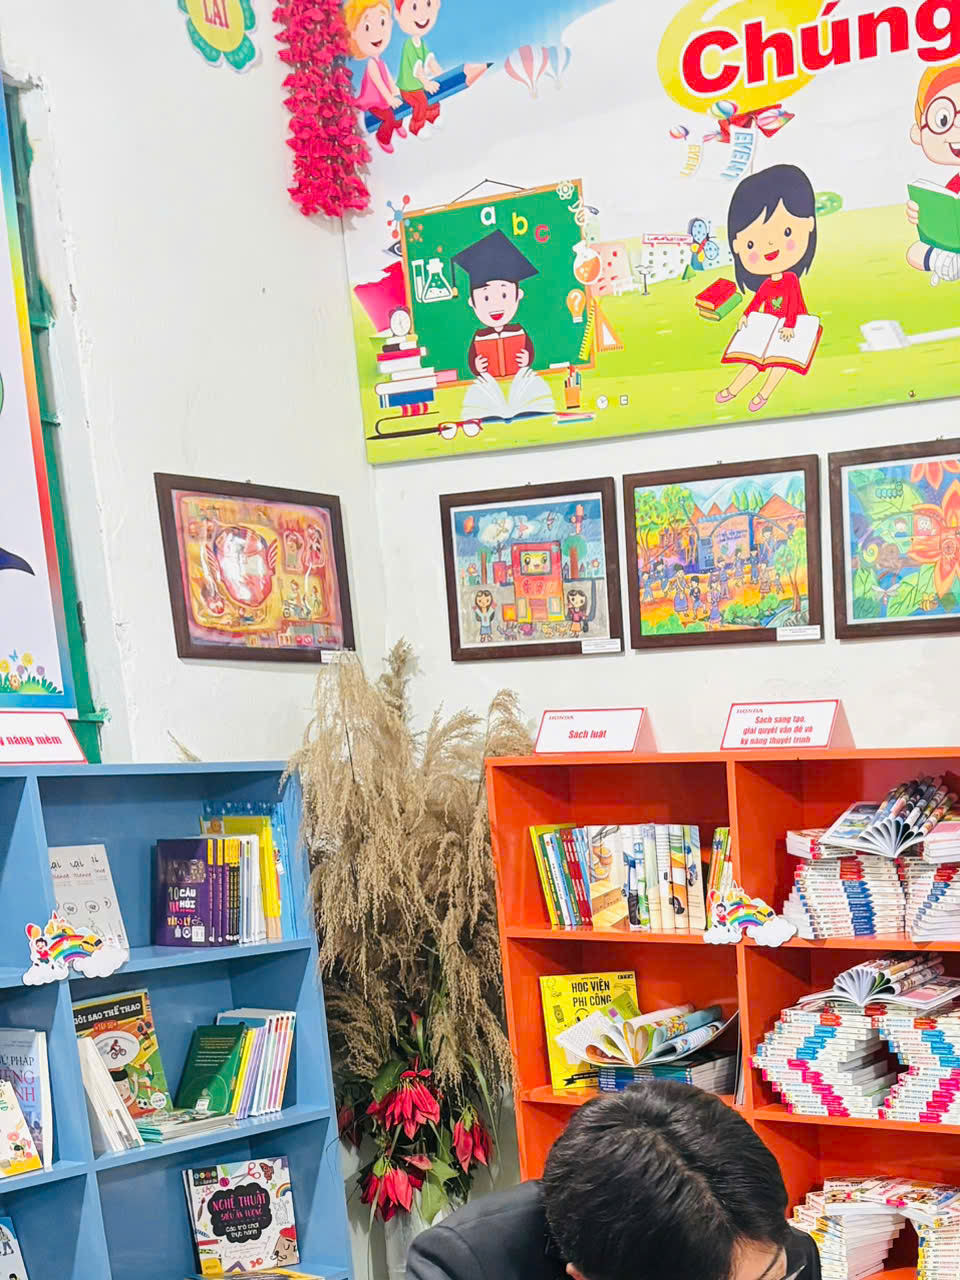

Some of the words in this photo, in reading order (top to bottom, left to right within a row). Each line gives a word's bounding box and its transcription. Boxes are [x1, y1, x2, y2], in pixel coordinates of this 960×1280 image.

[720, 131, 754, 179] EVENT
[479, 206, 496, 226] a
[511, 210, 529, 237] b
[534, 224, 550, 243] c
[572, 982, 589, 996] HỌC
[590, 978, 611, 993] VIỆN
[572, 996, 588, 1007] PHI
[589, 994, 612, 1007] CÔNG
[88, 1012, 103, 1022] SAO
[120, 1003, 141, 1014] THAO
